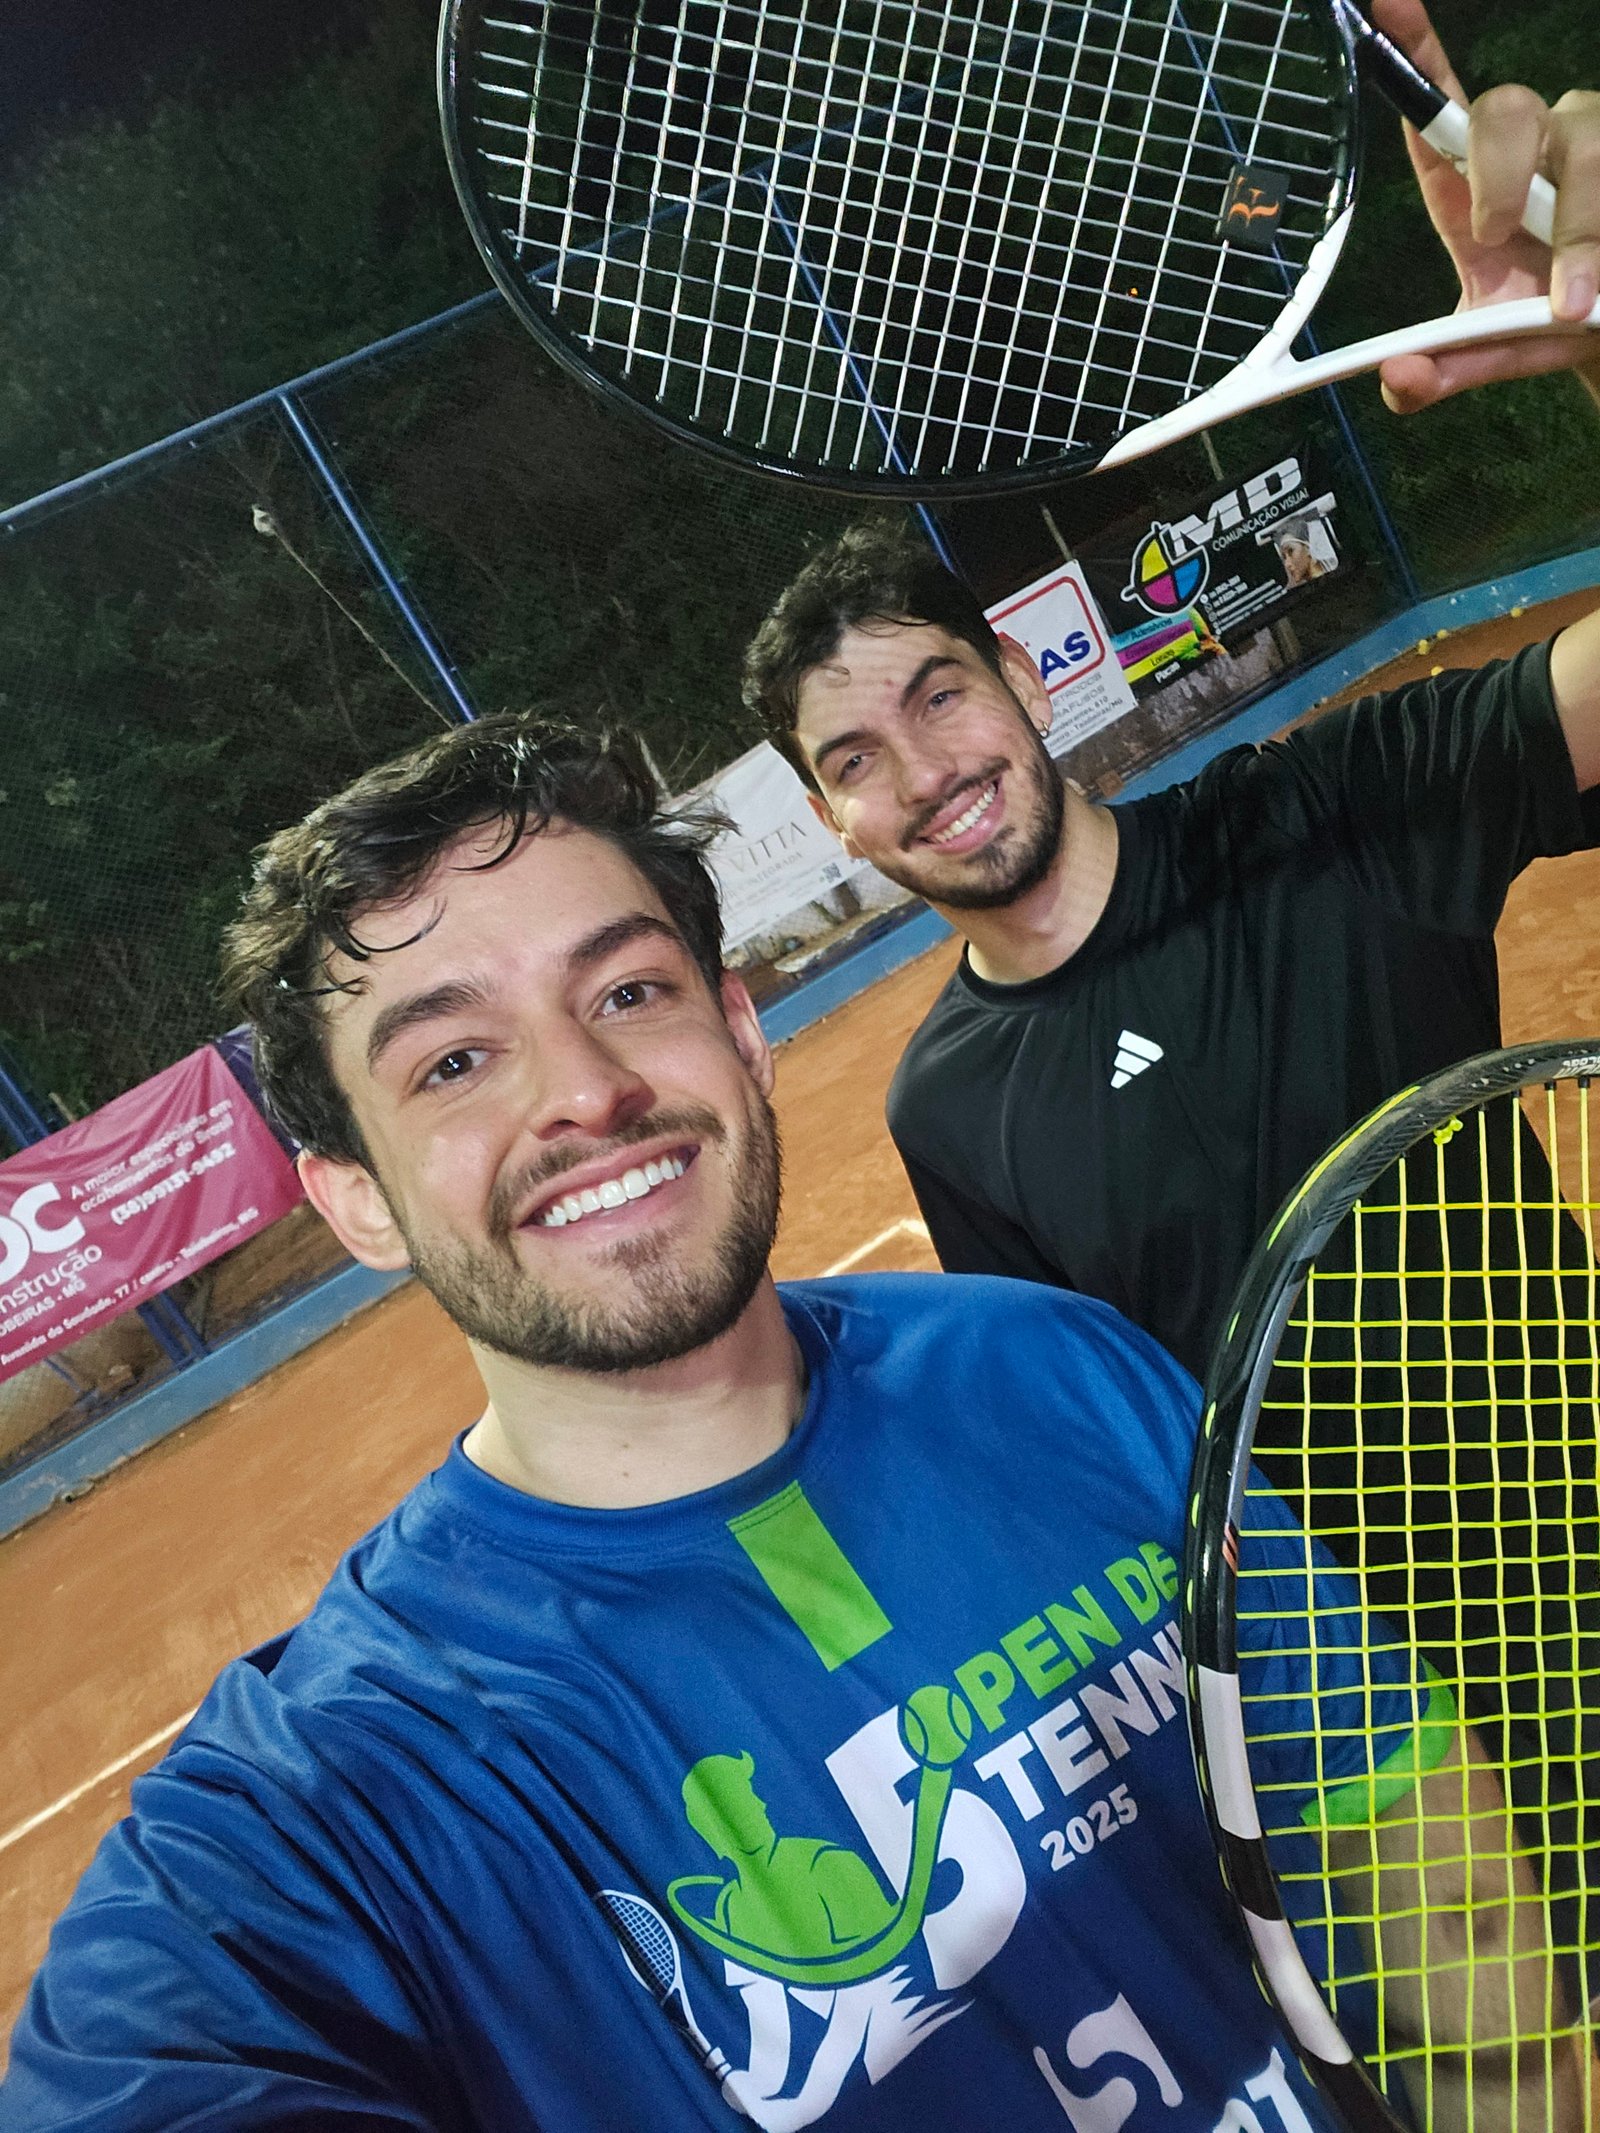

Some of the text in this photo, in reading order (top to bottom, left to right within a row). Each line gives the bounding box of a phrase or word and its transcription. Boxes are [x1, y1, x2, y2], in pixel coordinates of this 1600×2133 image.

[1170, 457, 1301, 557] MD
[1212, 505, 1279, 551] COMUNICAÇÃO
[729, 821, 807, 873] VITTA
[71, 1185, 84, 1199] A
[84, 1162, 126, 1192] maior
[209, 1100, 232, 1117] em
[195, 1113, 234, 1144] Brasil
[62, 1278, 86, 1299] MG
[1104, 1541, 1179, 1626] DE
[1040, 1784, 1138, 1871] 2025
